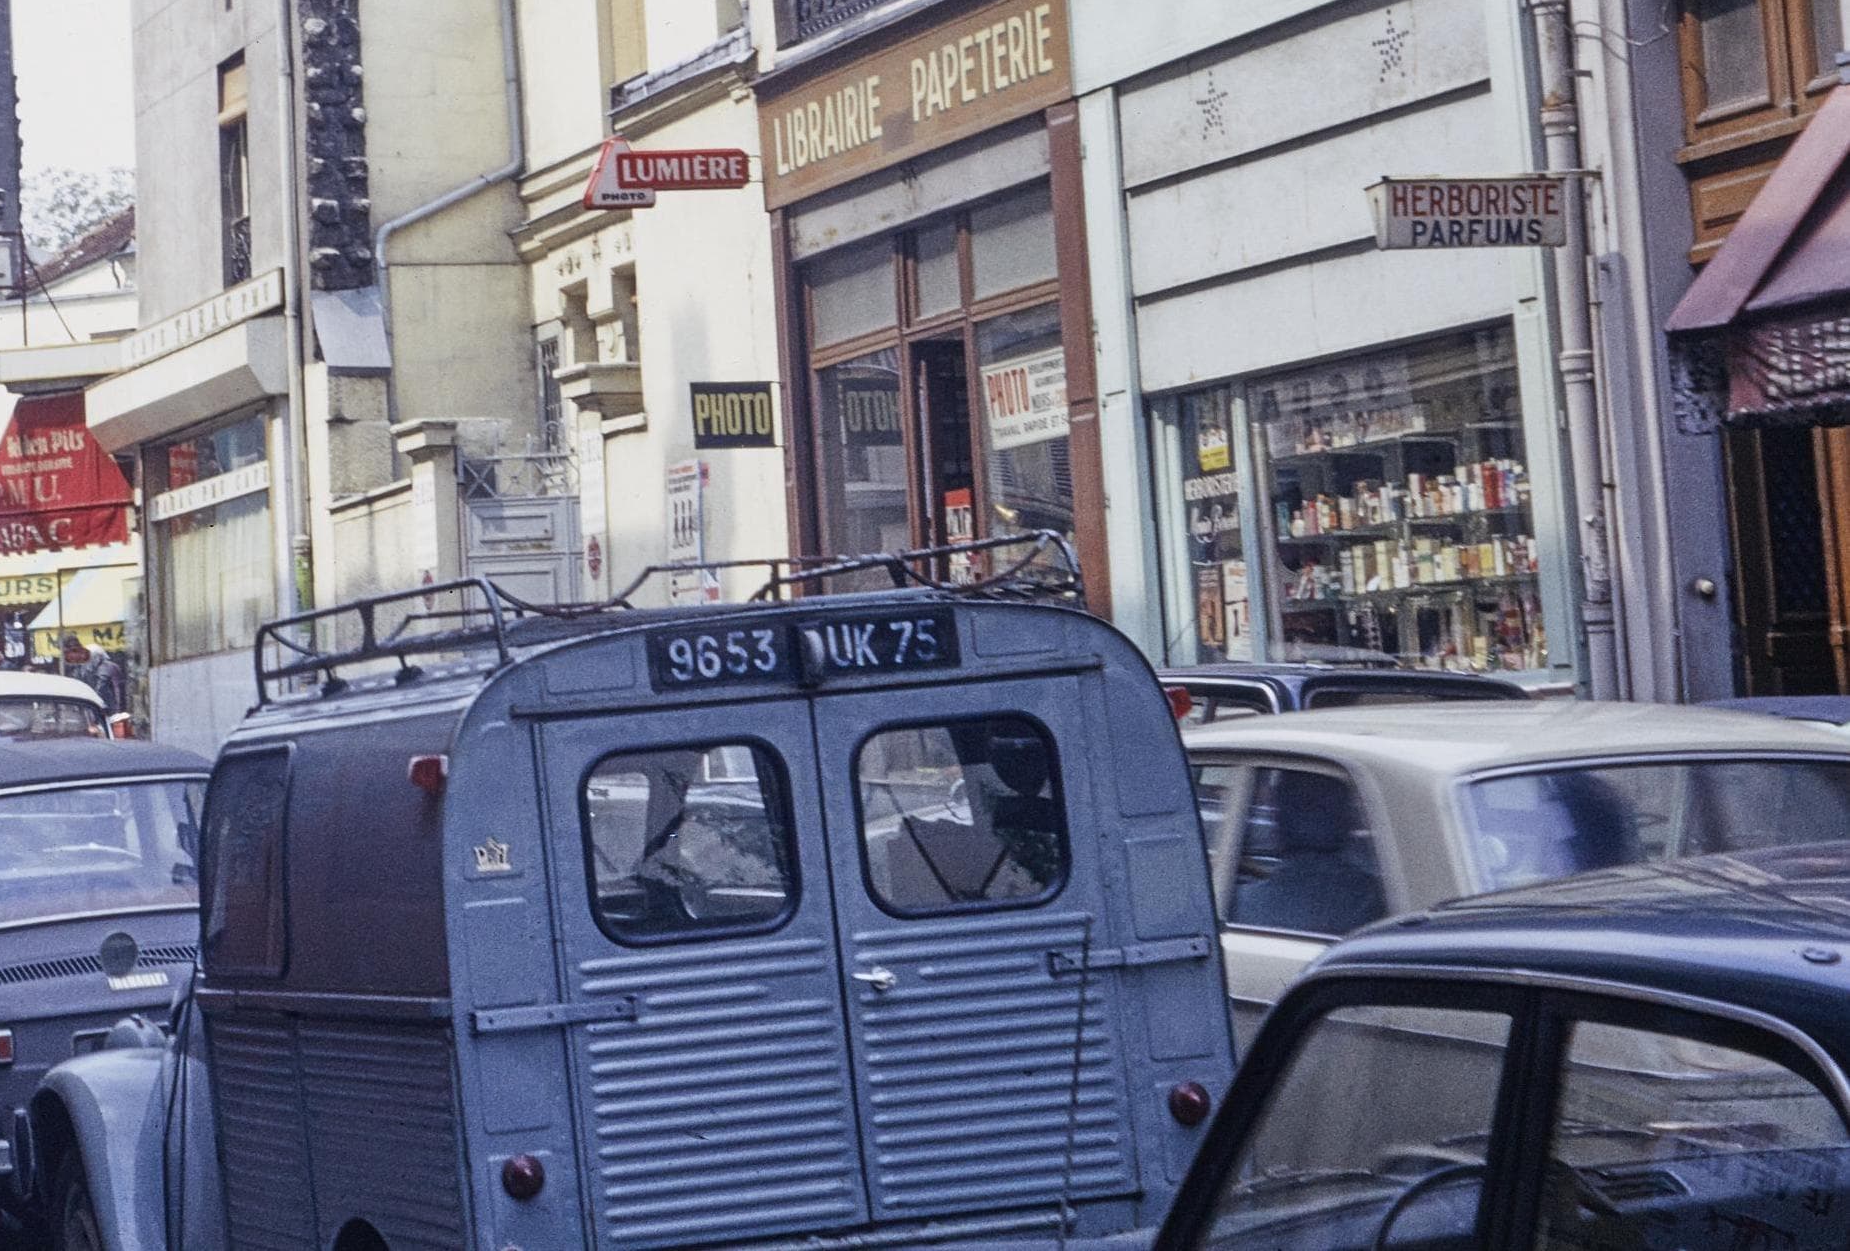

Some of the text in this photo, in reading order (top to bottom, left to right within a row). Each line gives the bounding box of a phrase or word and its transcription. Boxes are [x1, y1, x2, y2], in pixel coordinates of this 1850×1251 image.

[774, 3, 1053, 177] LIBRAIRIE PAPETERIE
[622, 155, 744, 182] LUMIÈRE
[602, 192, 646, 202] PHOTO
[1392, 183, 1559, 217] HERBORISTE
[1411, 218, 1544, 246] PARFUMS
[987, 367, 1030, 420] PHOTO
[694, 392, 770, 435] PHOTO
[669, 629, 777, 681] 9653
[888, 619, 937, 664] 75
